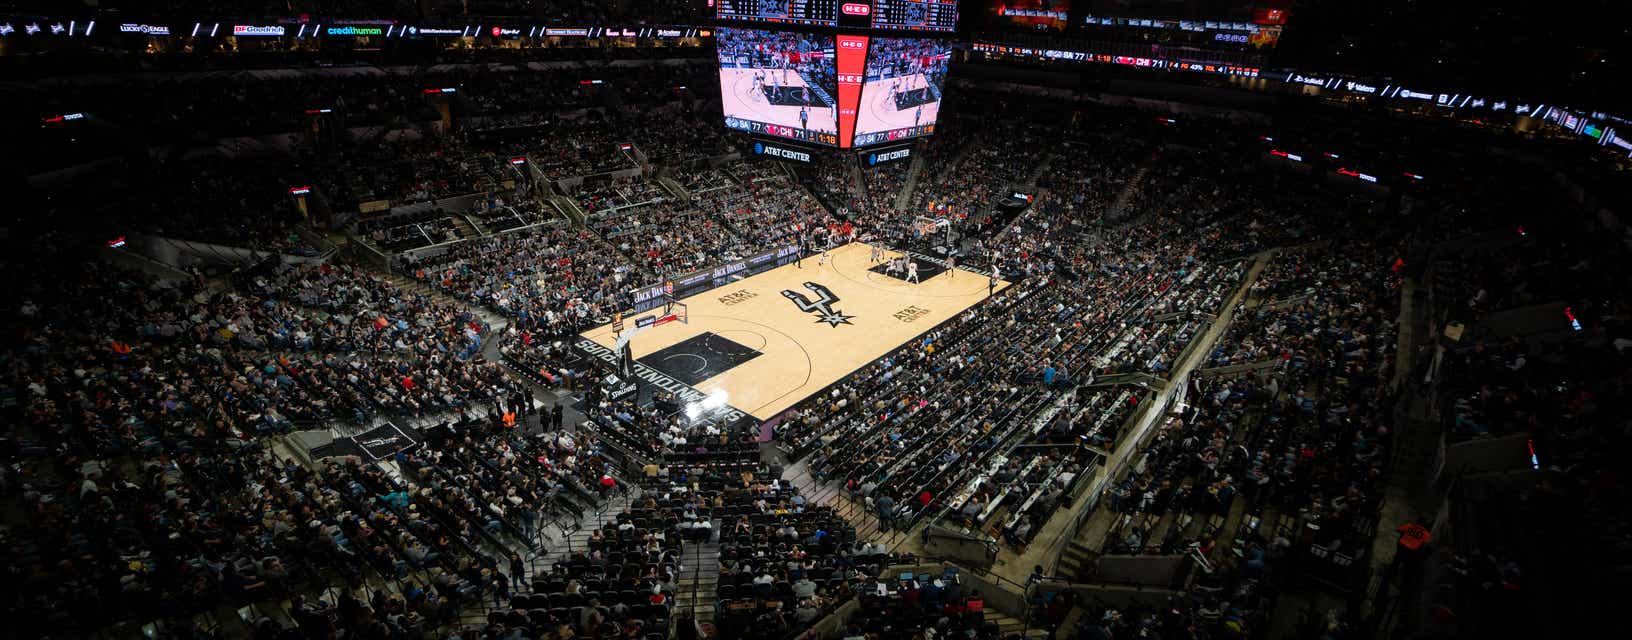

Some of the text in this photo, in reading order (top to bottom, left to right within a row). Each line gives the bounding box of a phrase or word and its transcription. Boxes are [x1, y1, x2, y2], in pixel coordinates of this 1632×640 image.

[234, 25, 284, 34] BFGoodrich
[327, 26, 381, 35] credithuman
[1074, 52, 1085, 60] 77
[1136, 57, 1150, 66] CHI
[740, 120, 761, 131] SA 77
[780, 127, 794, 137] CHI
[795, 130, 806, 138] 71
[819, 134, 836, 144] 1:18
[908, 127, 916, 136] 71
[866, 132, 885, 143] SA 77
[764, 146, 810, 162] AT&T CENTER
[890, 149, 910, 160] CENTER
[713, 268, 726, 278] JACK
[634, 291, 651, 303] JACK
[718, 289, 751, 304] AT&T
[893, 305, 921, 320] AT&T
[611, 383, 637, 399] SPALDING
